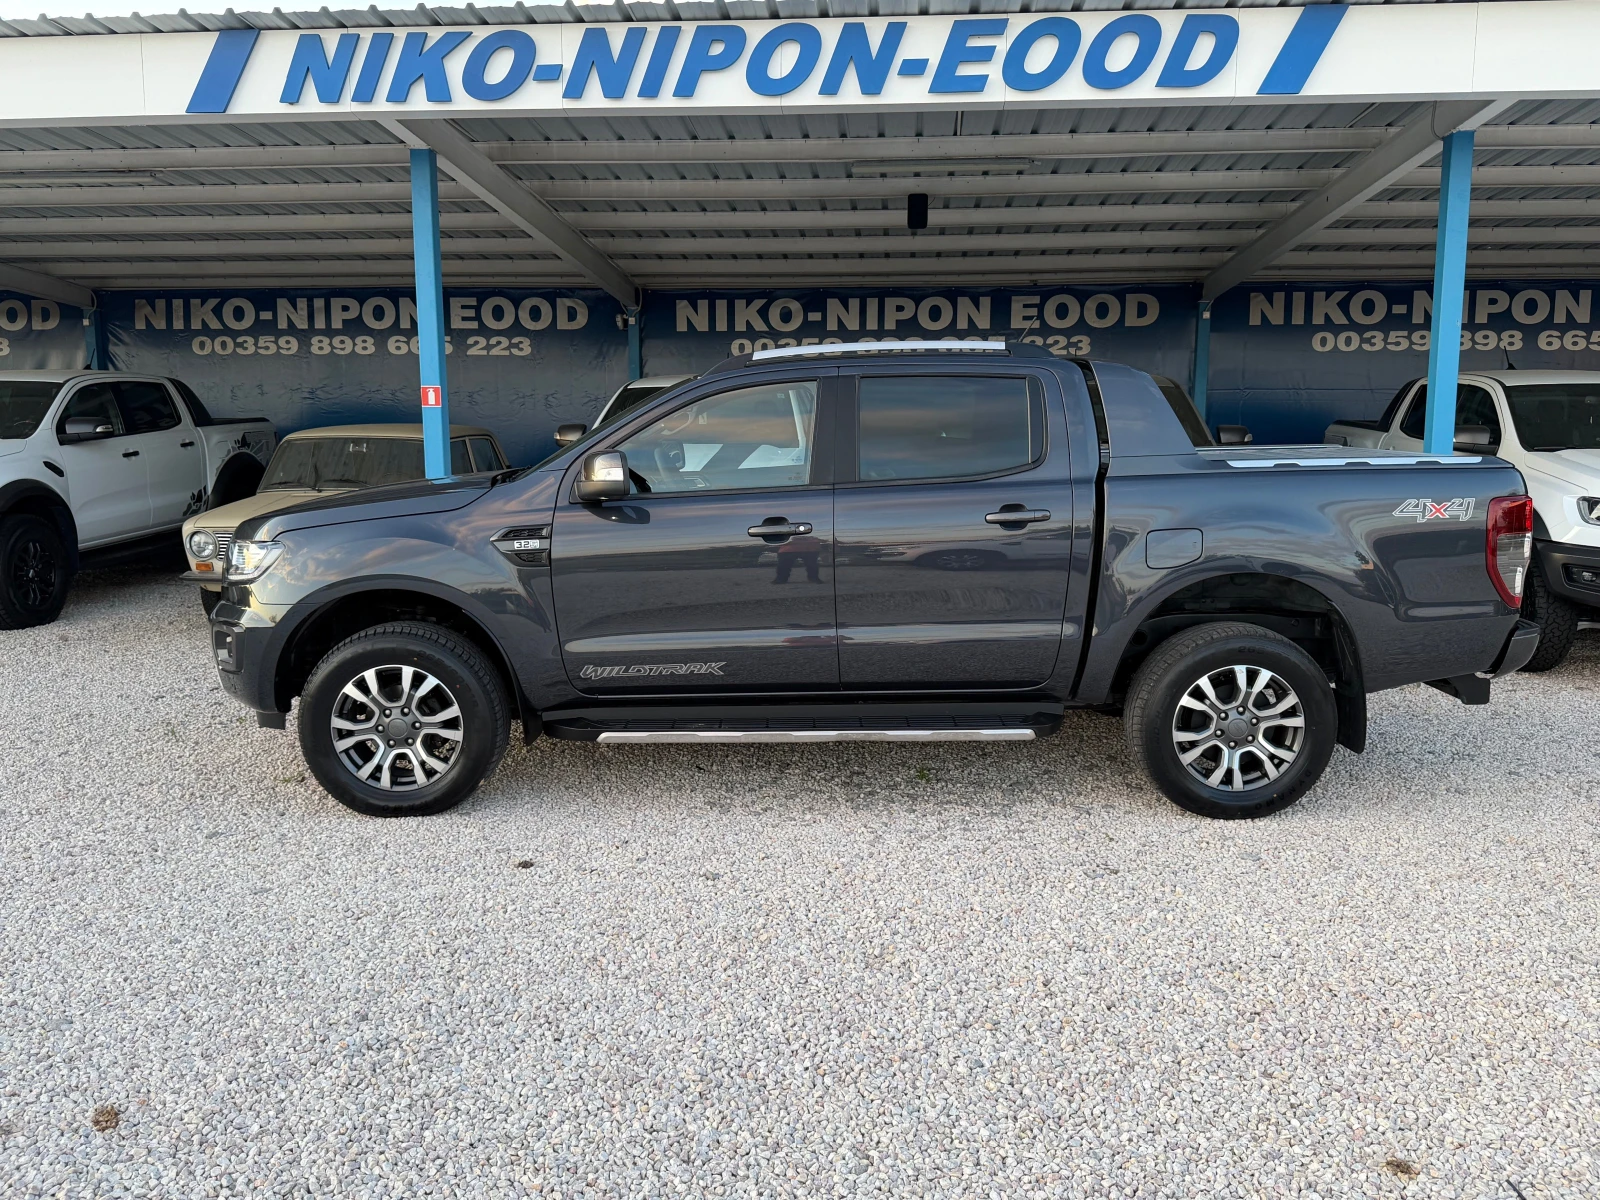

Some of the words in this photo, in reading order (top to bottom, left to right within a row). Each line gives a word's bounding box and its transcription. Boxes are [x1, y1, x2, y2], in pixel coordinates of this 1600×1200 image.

[279, 13, 1240, 105] NIKO-NIPON-EOOD
[450, 296, 589, 330] EOOD
[675, 297, 991, 332] NIKO-NIPON
[1010, 293, 1160, 329] EOOD
[191, 335, 299, 355] 00359
[310, 335, 376, 355] 898
[466, 335, 532, 356] 223
[1311, 329, 1431, 352] 00359
[579, 661, 727, 680] WILDTRAK
